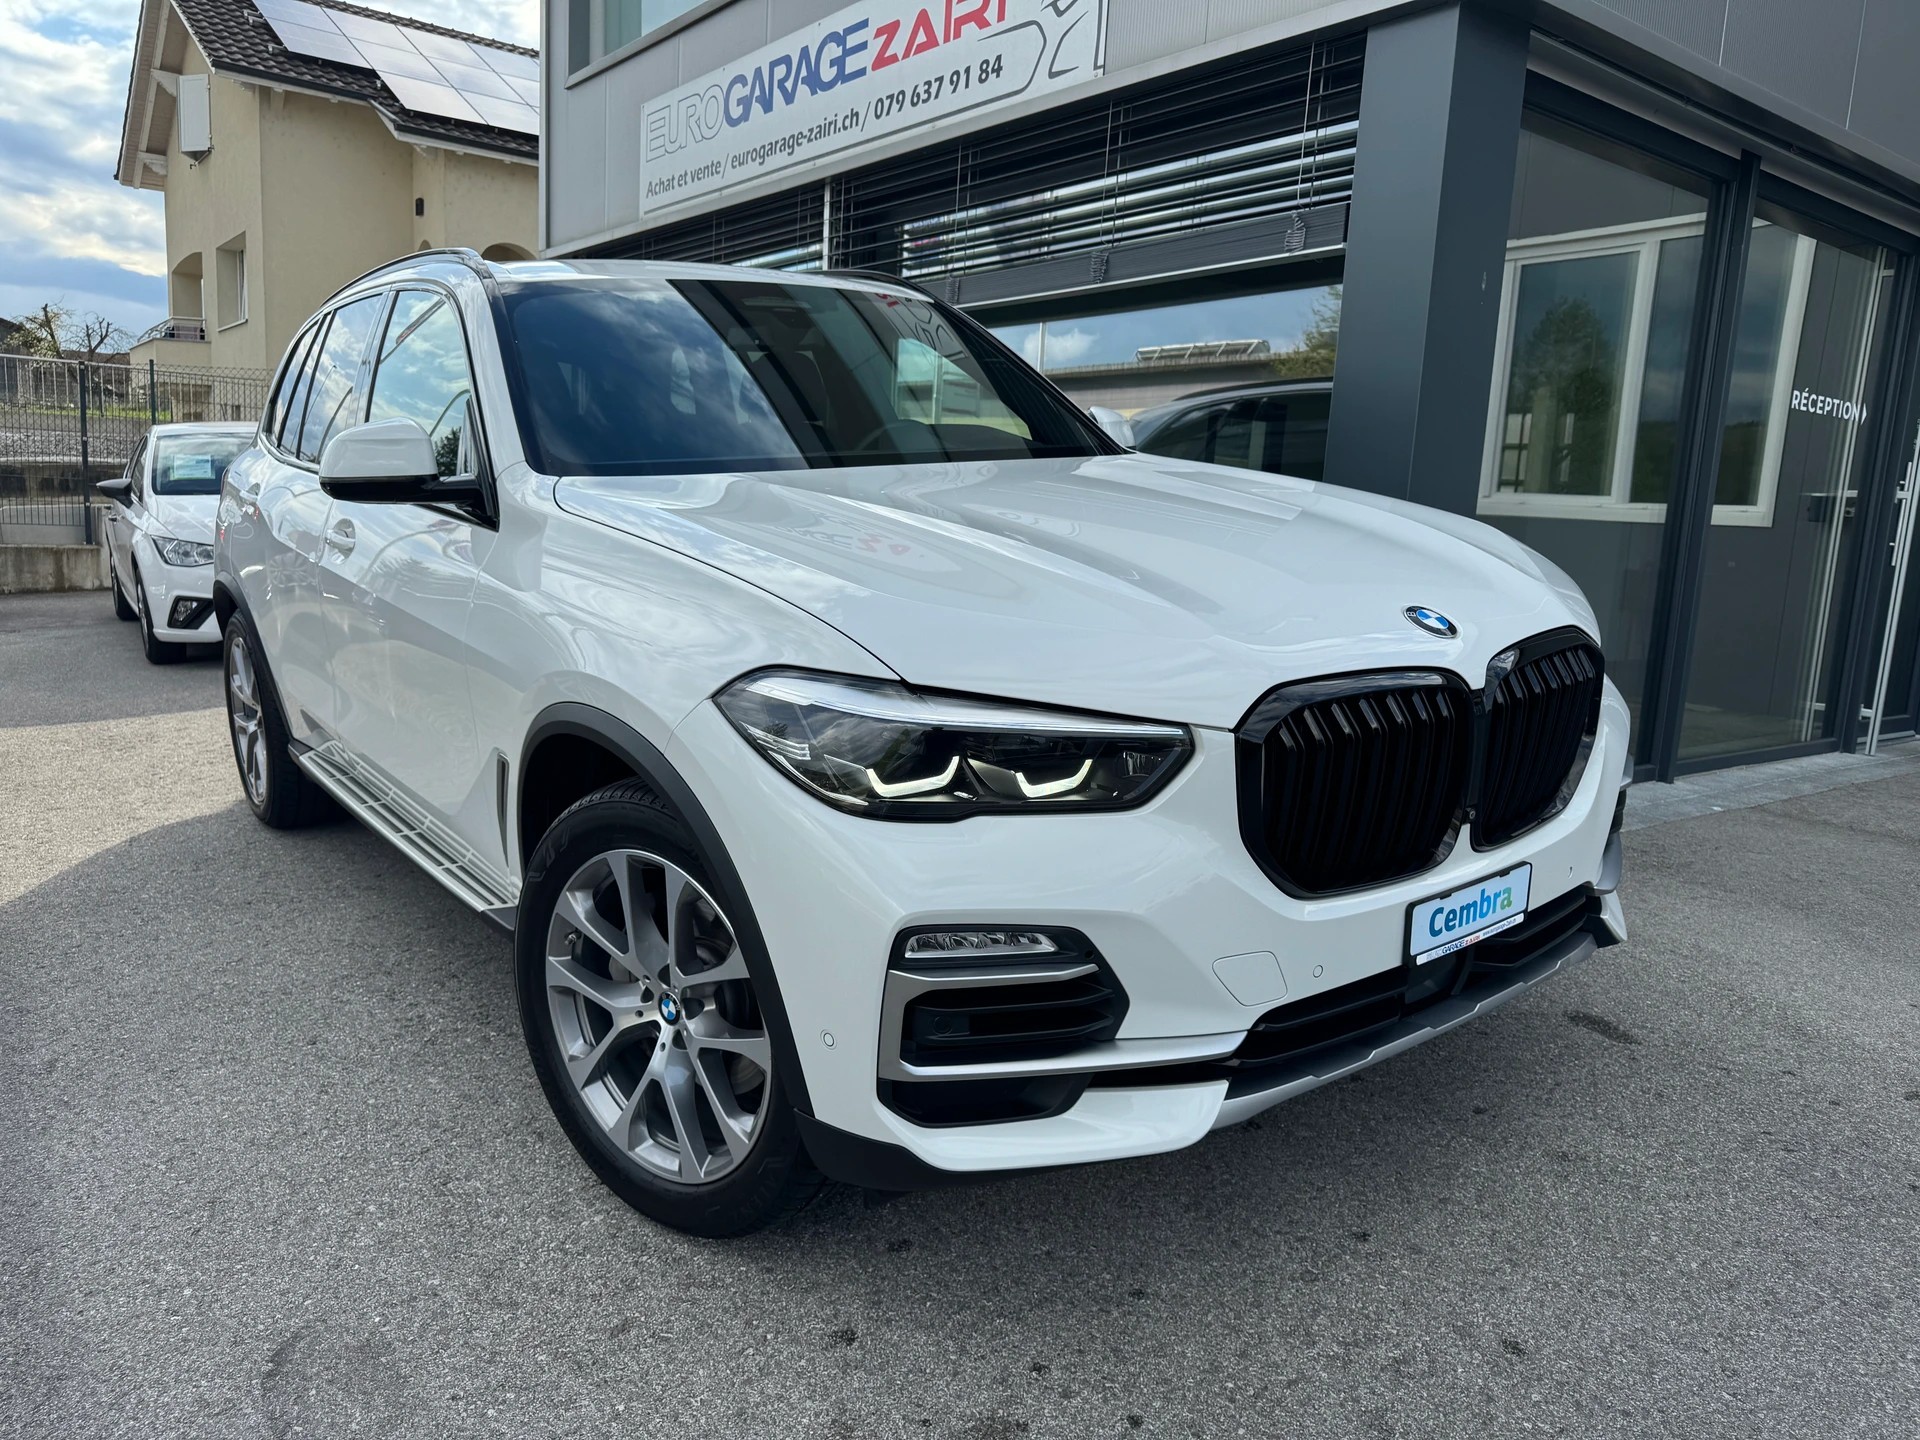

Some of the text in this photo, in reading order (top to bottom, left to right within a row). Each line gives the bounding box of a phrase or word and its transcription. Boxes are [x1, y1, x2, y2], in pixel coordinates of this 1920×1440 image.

[646, 174, 675, 199] Achat
[677, 169, 688, 187] et
[690, 160, 722, 183] vente
[731, 108, 859, 169] eurogarage-zairi.ch
[874, 90, 906, 120] 079
[910, 75, 944, 108] 637
[950, 65, 971, 94] 91
[978, 54, 1003, 84] 84
[1791, 387, 1860, 421] RÉCEPTION
[1429, 887, 1512, 937] Cembra
